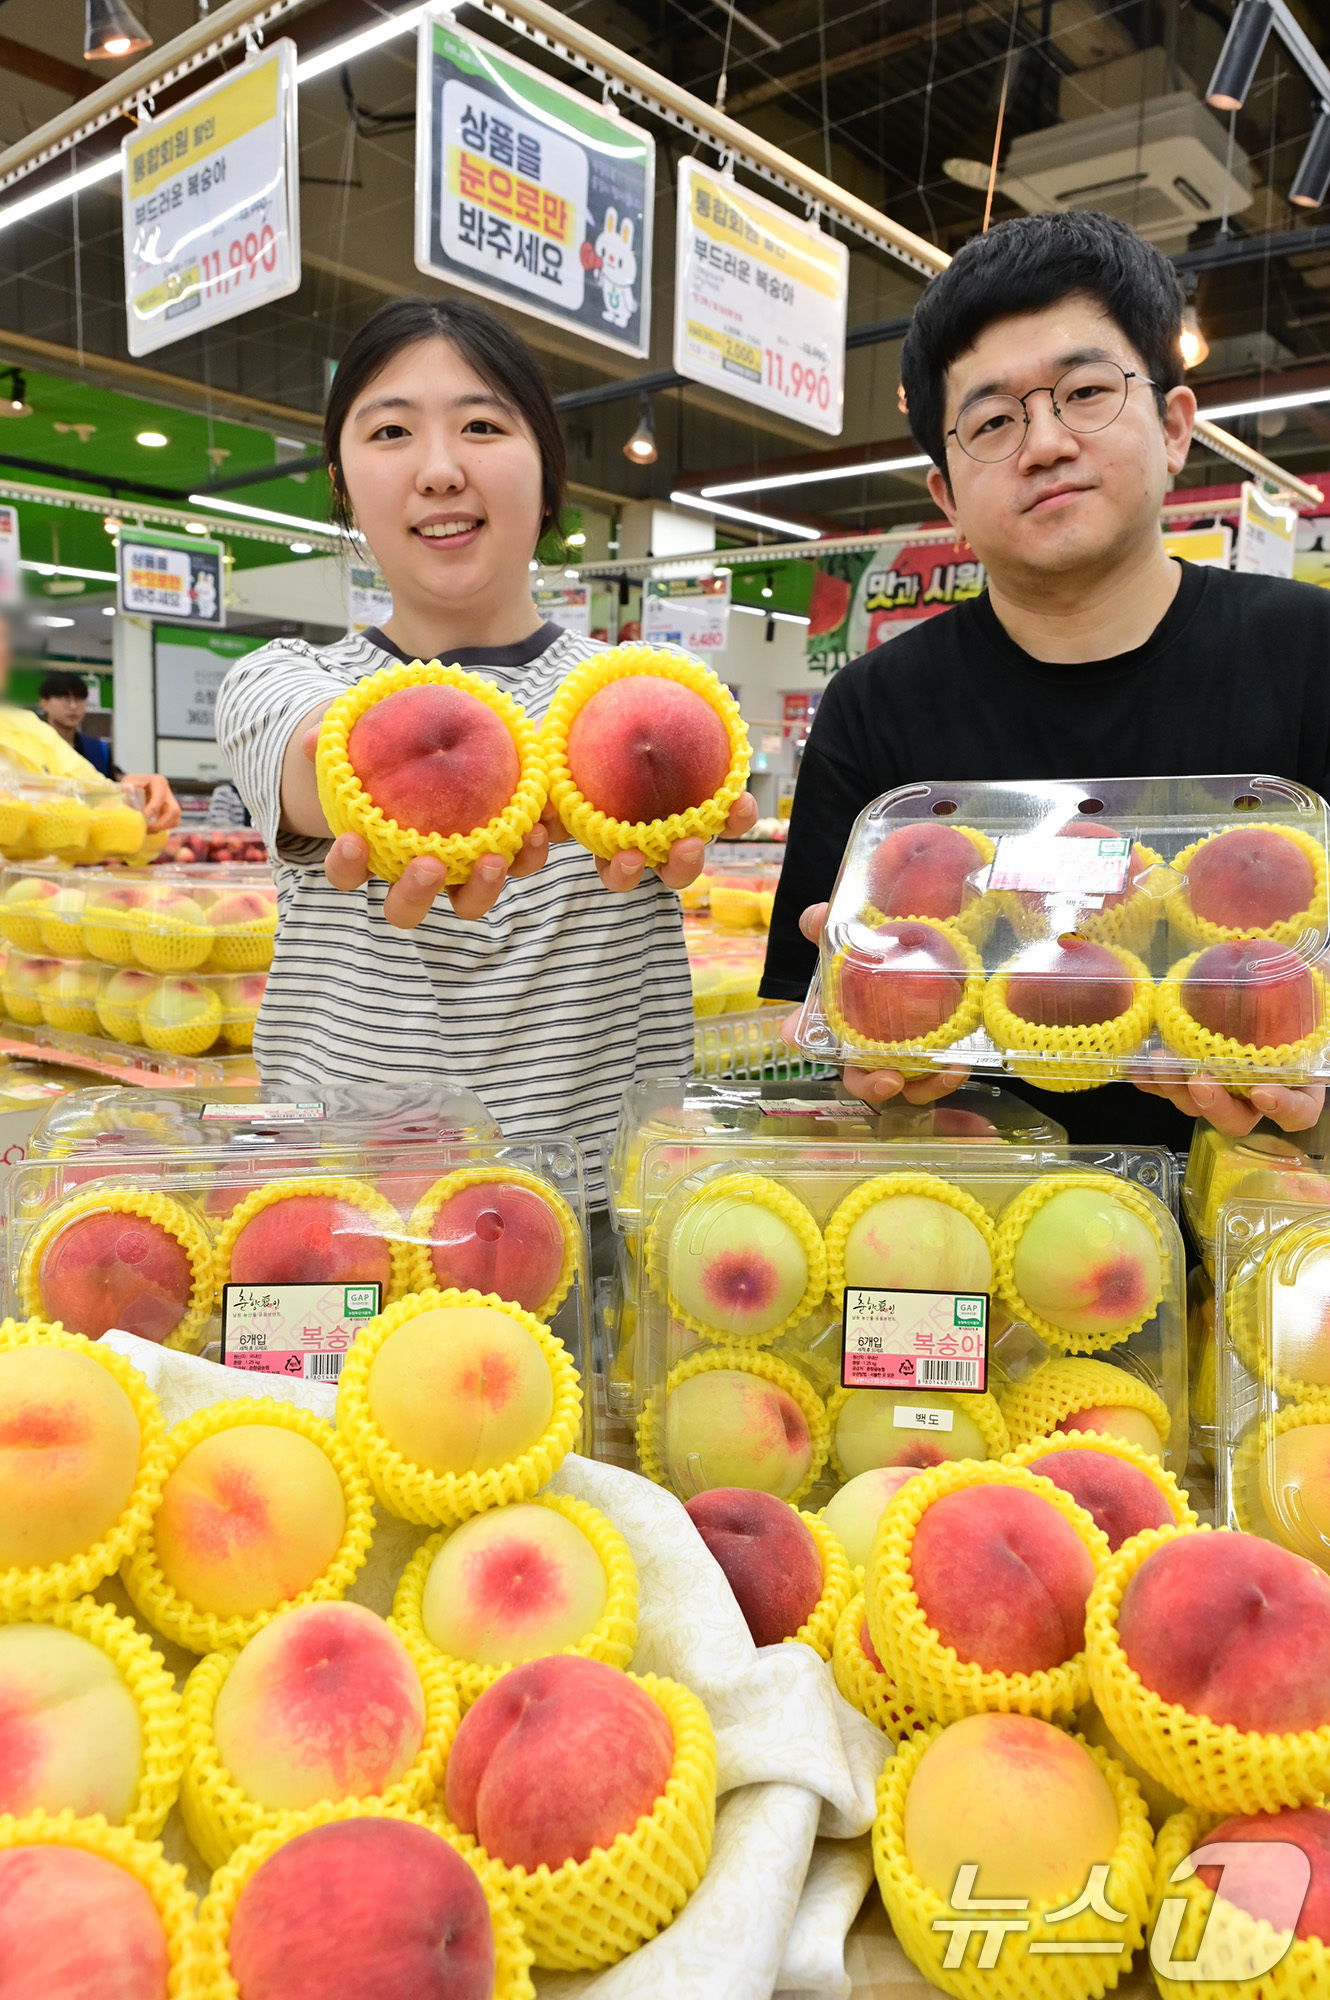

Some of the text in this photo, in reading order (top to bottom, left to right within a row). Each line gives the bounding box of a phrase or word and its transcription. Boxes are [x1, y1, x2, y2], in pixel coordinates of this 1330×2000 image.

[461, 104, 541, 181] 상품을
[135, 156, 226, 225] 부드러운 복숭아
[460, 152, 567, 241] 눈으로만
[203, 225, 276, 299] 11,990
[458, 202, 562, 286] 봐주세요
[695, 236, 752, 284] 부드러운
[756, 267, 794, 307] 복숭아
[766, 348, 830, 411] 11,990
[866, 569, 922, 611] 맛과
[351, 1293, 369, 1301] GAP
[960, 1303, 978, 1312] GAP
[239, 1333, 266, 1346] 6개입
[300, 1325, 362, 1349] 복숭
[858, 1336, 882, 1348] 6개입
[913, 1332, 984, 1357] 복숭아
[915, 1413, 939, 1425] 백도
